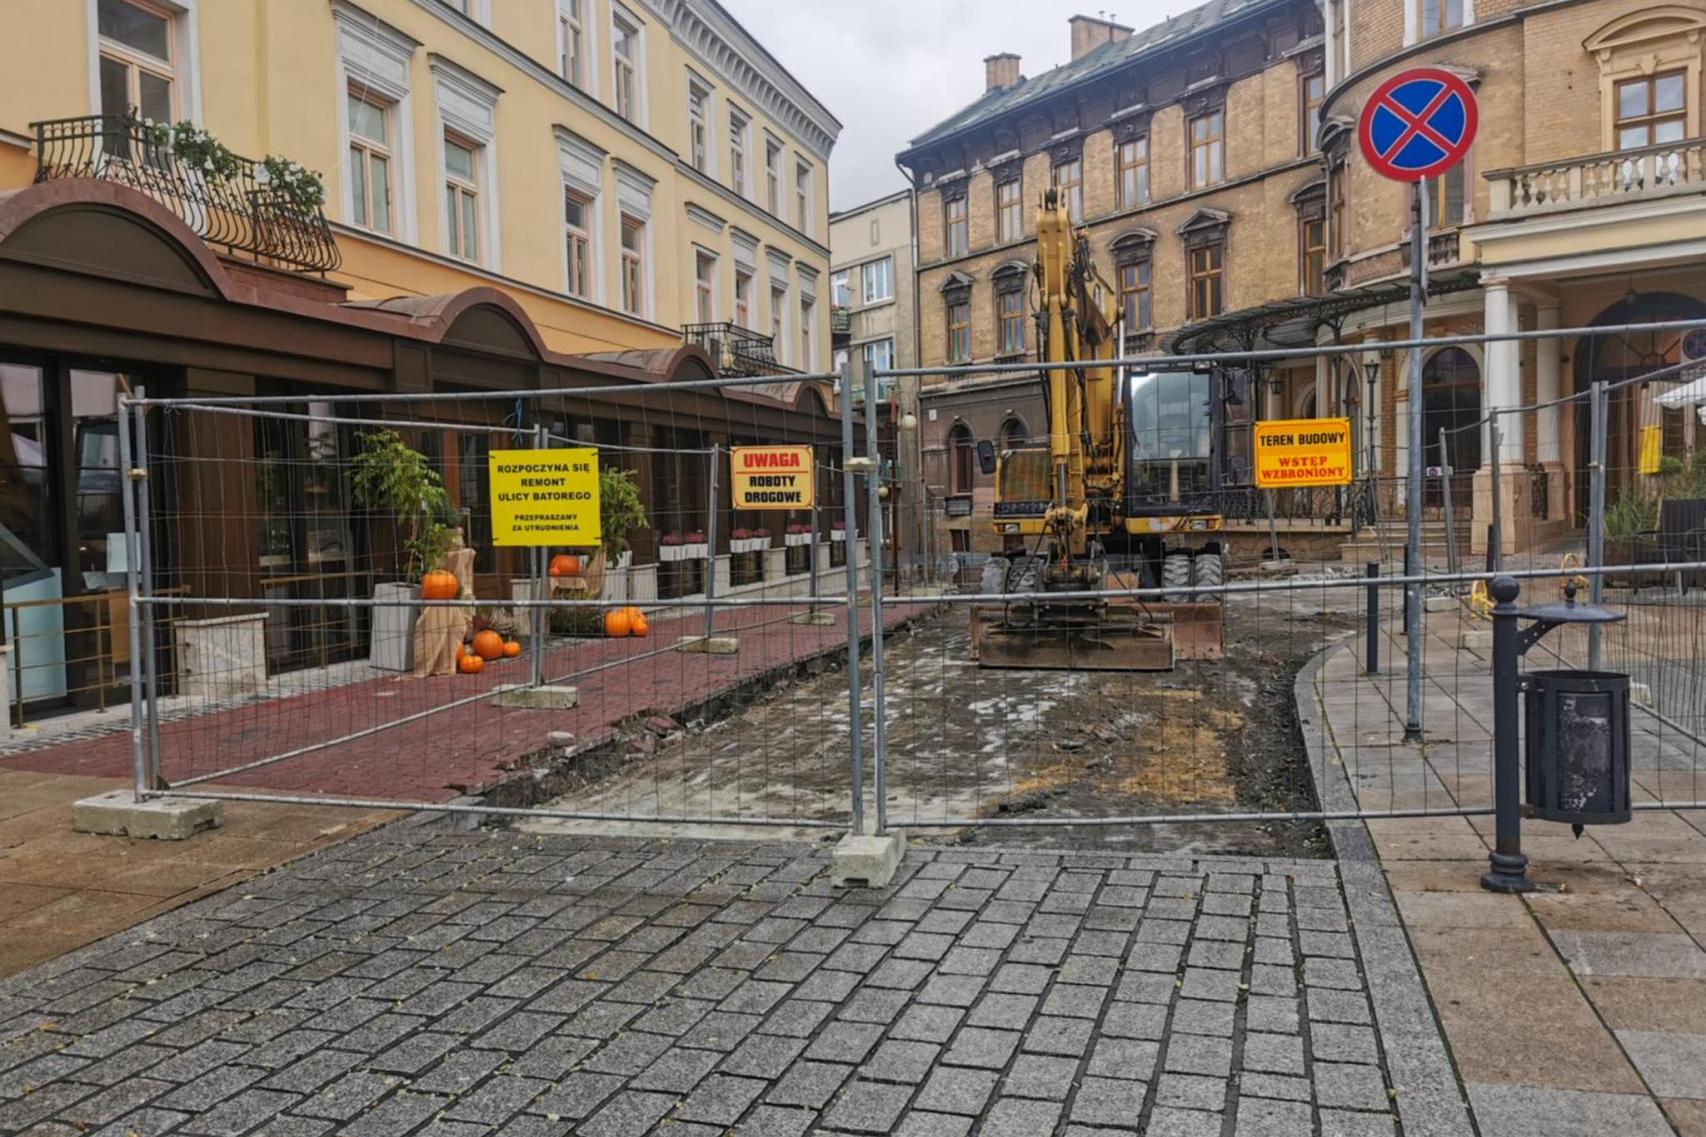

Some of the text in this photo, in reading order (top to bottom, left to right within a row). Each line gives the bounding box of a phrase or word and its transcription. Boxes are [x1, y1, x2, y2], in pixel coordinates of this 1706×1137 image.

[1260, 432, 1345, 446] TEREN BUDOWY
[743, 453, 800, 468] UWAGA
[497, 463, 590, 474] ROZPOCZYNA SIĘ
[1262, 467, 1344, 479] WZBRONIONY
[521, 478, 565, 487] REMONT
[749, 476, 796, 487] ROBOTY
[498, 491, 591, 501] ULICY BATOREGO
[744, 491, 801, 503] DROGOWE
